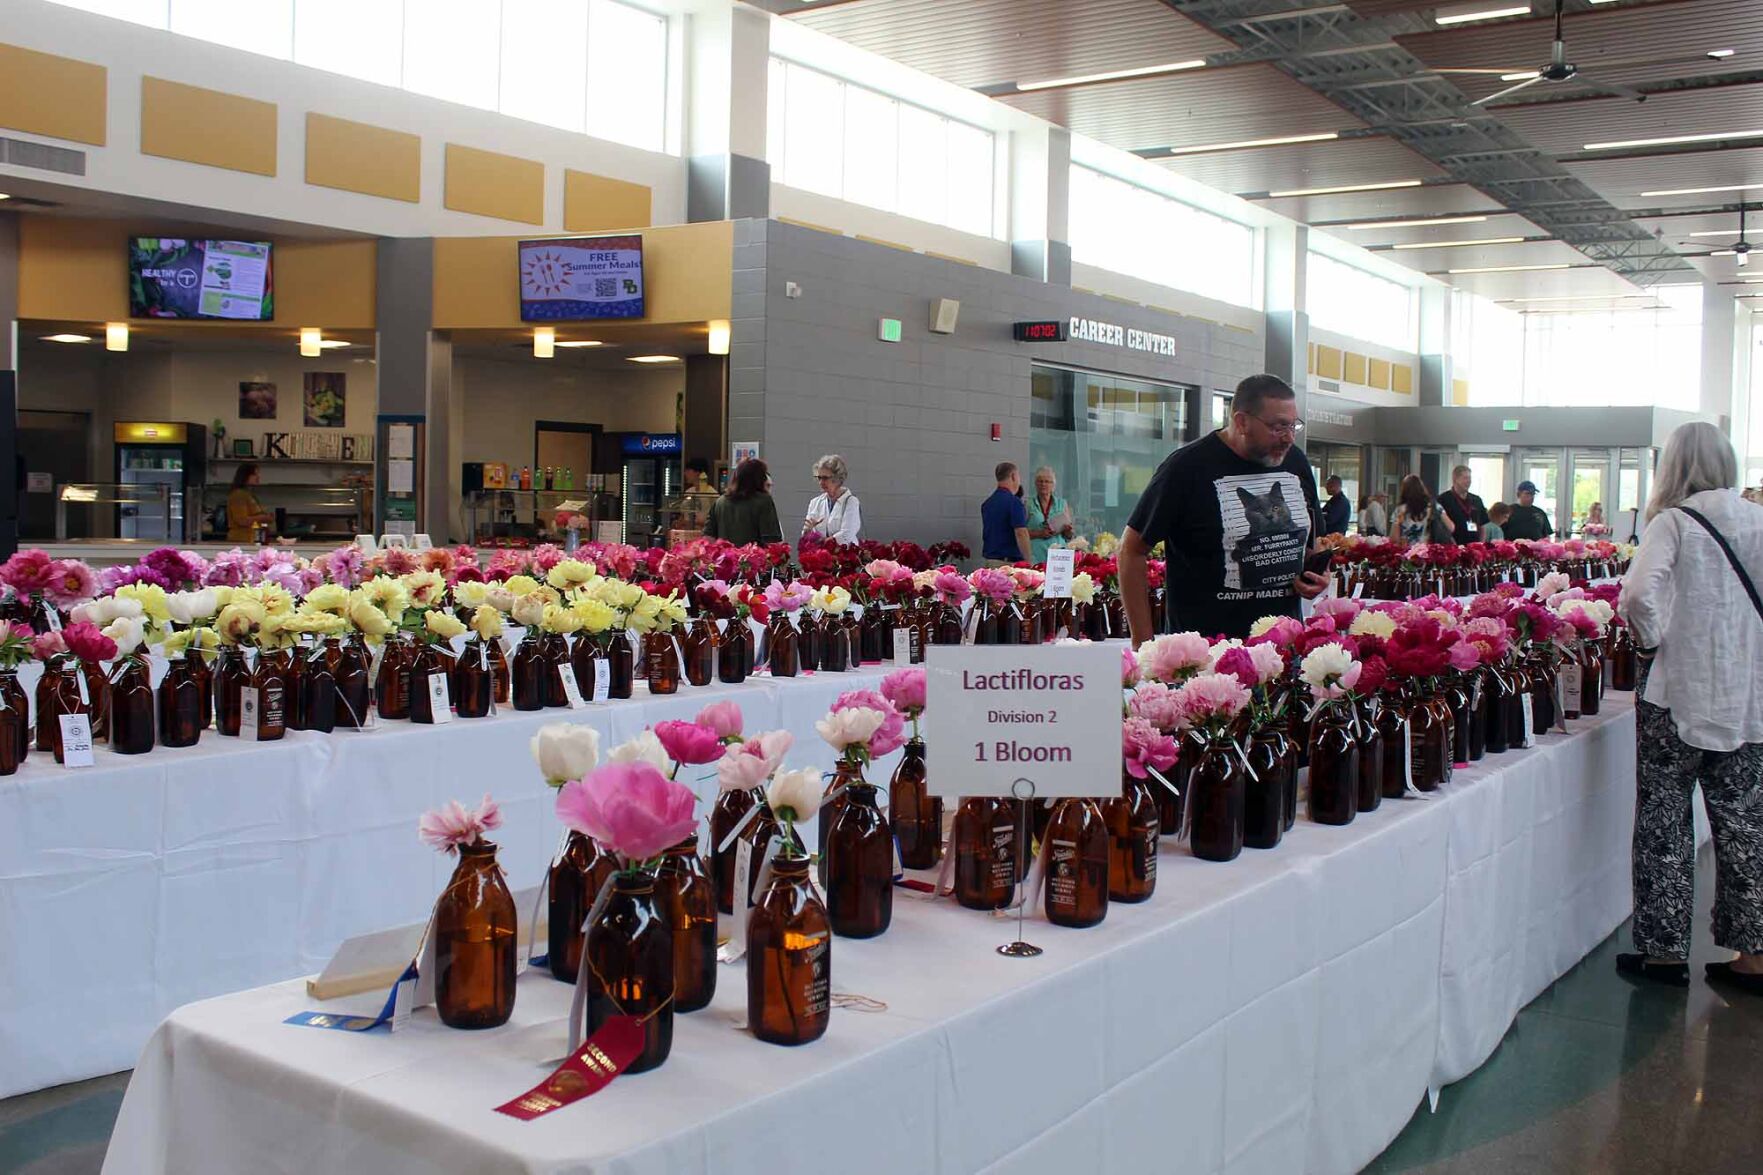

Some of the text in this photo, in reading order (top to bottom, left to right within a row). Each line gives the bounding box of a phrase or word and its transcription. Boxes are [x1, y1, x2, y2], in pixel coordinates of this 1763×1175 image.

[589, 252, 618, 262] FREE
[142, 268, 177, 278] HEALTHY
[567, 262, 607, 271] Summer
[1069, 316, 1176, 357] CAREER CENTER
[651, 437, 676, 450] pepsi
[1242, 550, 1283, 563] DISORDERLY
[1255, 559, 1270, 567] BAD
[1262, 576, 1277, 584] CITY
[1216, 591, 1253, 600] CATNIP
[1256, 589, 1284, 599] MADE
[963, 669, 1084, 690] Lactifloras
[988, 710, 1057, 723] Division 2
[975, 740, 1072, 762] 1 Bloom
[587, 1042, 618, 1073] SECOND
